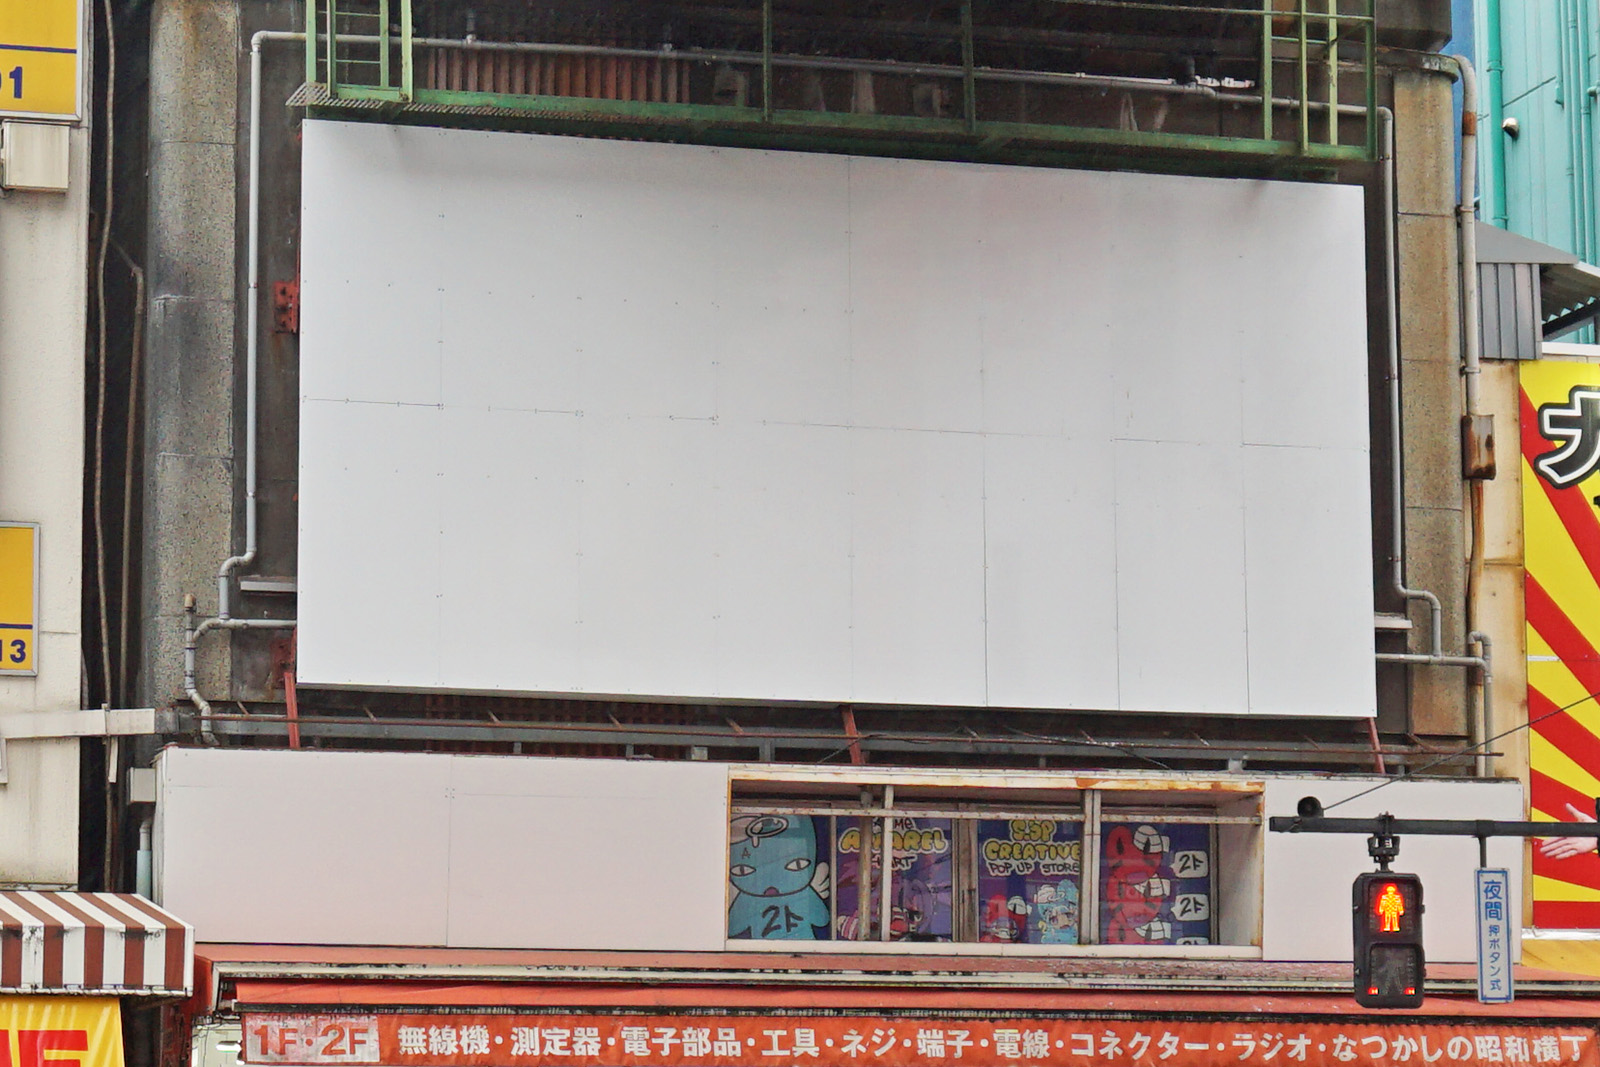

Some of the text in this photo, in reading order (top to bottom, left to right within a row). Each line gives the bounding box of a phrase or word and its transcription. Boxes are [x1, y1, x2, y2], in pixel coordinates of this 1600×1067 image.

[984, 840, 1080, 860] CREATIVE
[988, 861, 1012, 873] POP
[1016, 861, 1033, 873] UP
[1484, 880, 1502, 990] 夜間 押ボタン式
